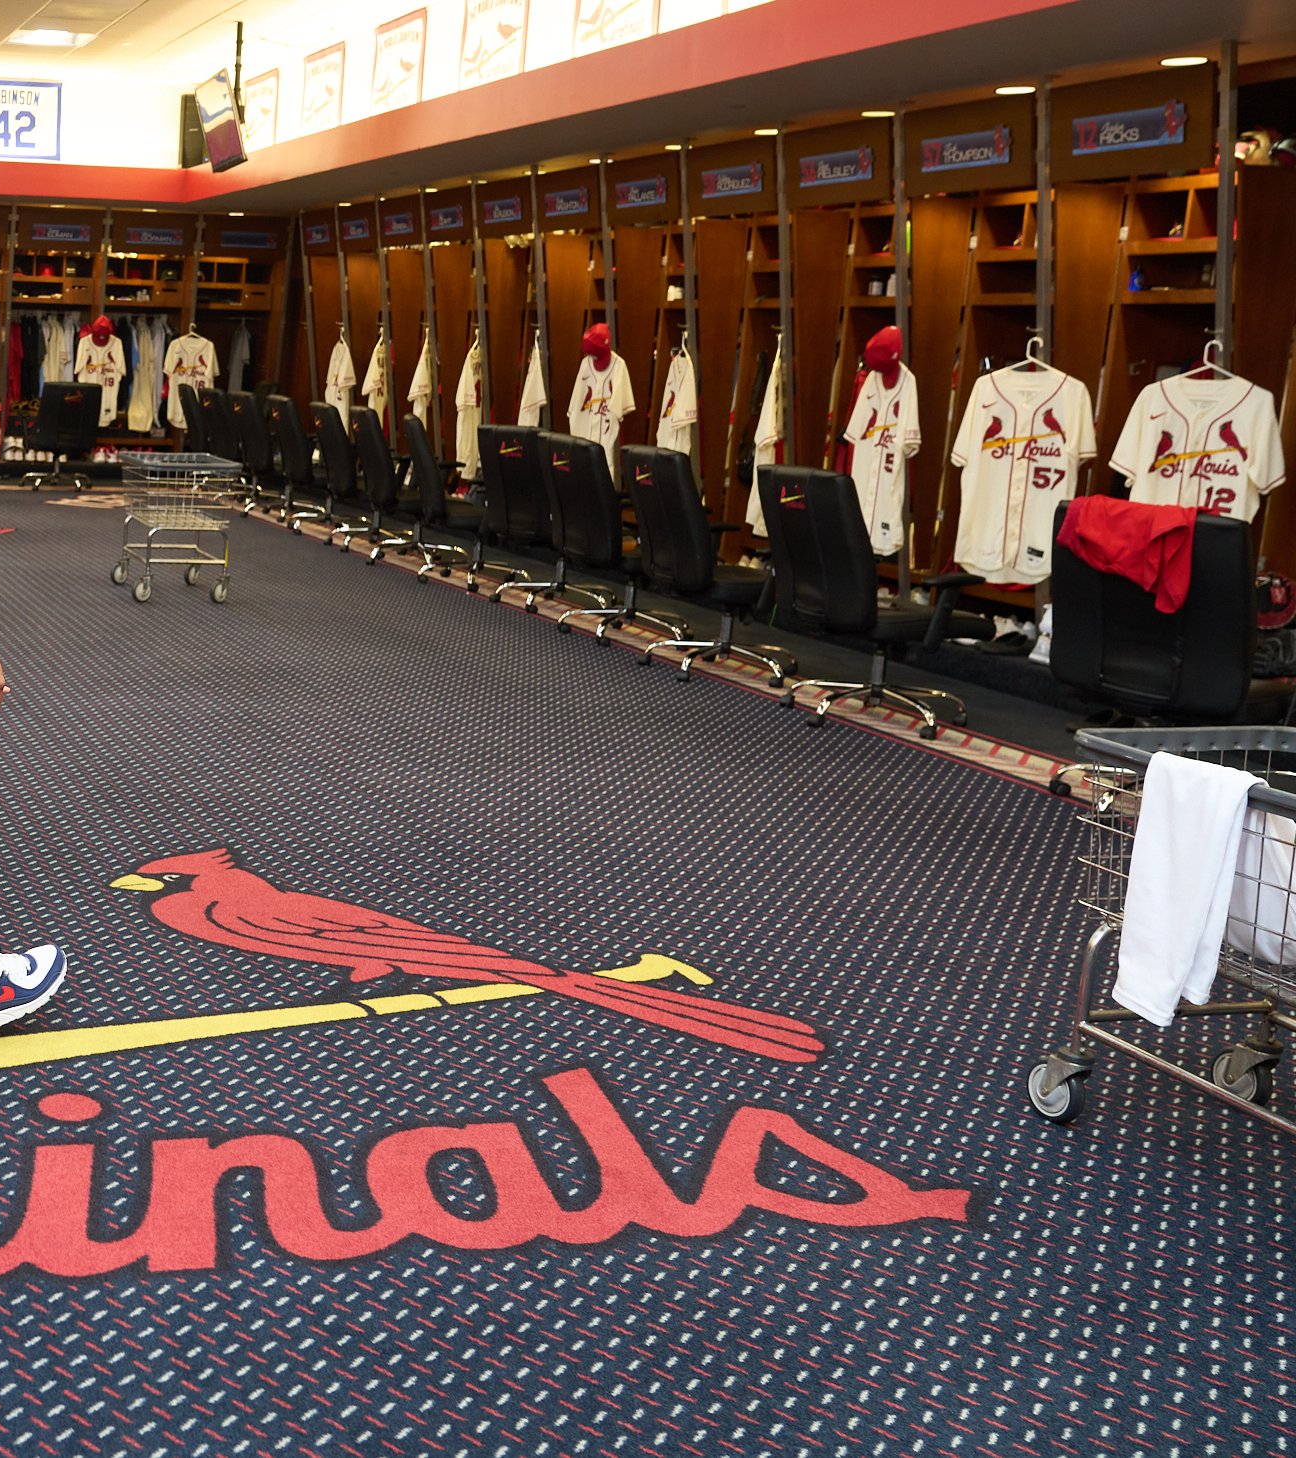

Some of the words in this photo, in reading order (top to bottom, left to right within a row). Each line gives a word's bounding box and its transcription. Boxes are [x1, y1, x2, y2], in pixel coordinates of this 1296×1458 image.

[1099, 128, 1140, 145] HICKS
[943, 147, 993, 164] THOMPSON
[1017, 438, 1061, 463] Louis
[1032, 467, 1066, 490] 57
[1190, 454, 1239, 481] Louis
[1204, 486, 1237, 514] 12
